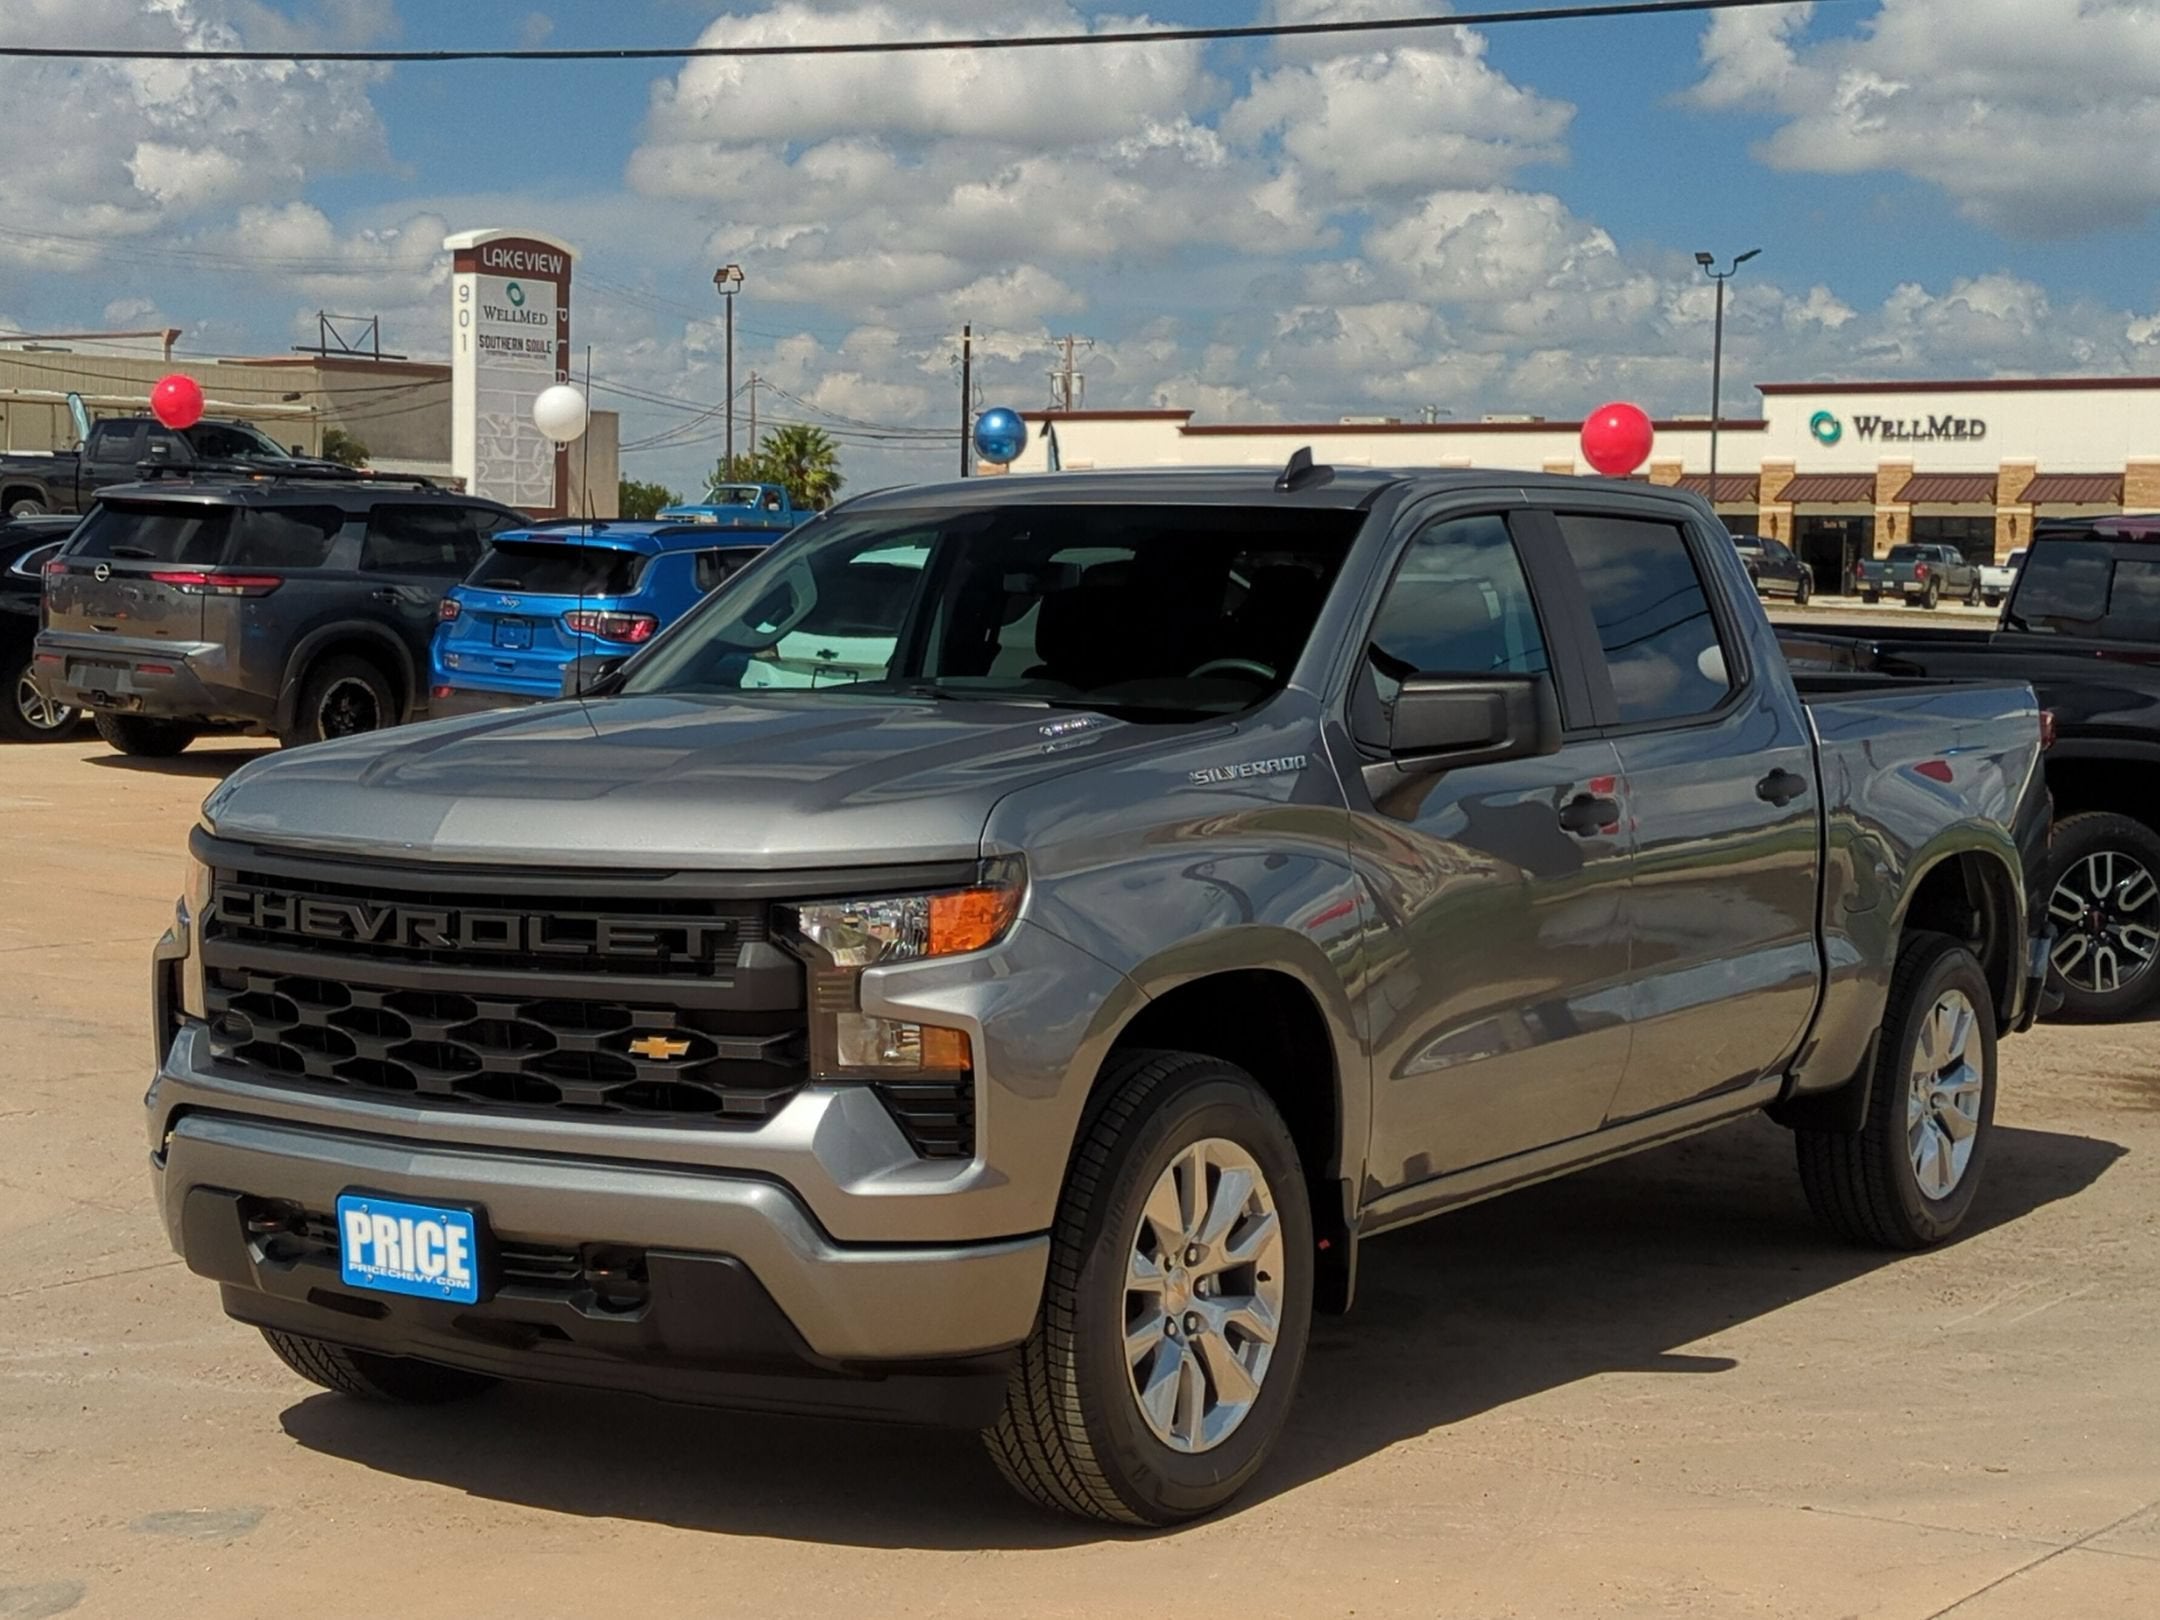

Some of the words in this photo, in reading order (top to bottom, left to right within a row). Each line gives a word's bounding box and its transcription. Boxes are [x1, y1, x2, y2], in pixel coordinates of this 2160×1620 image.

[483, 247, 563, 275] LAKEVIEW
[479, 334, 523, 351] SOUTHERN
[1190, 755, 1307, 785] SILVERADO
[214, 887, 730, 959] CHEVROLET
[345, 1210, 470, 1280] PRICE
[349, 1262, 470, 1289] PRICECHEVY.COM
